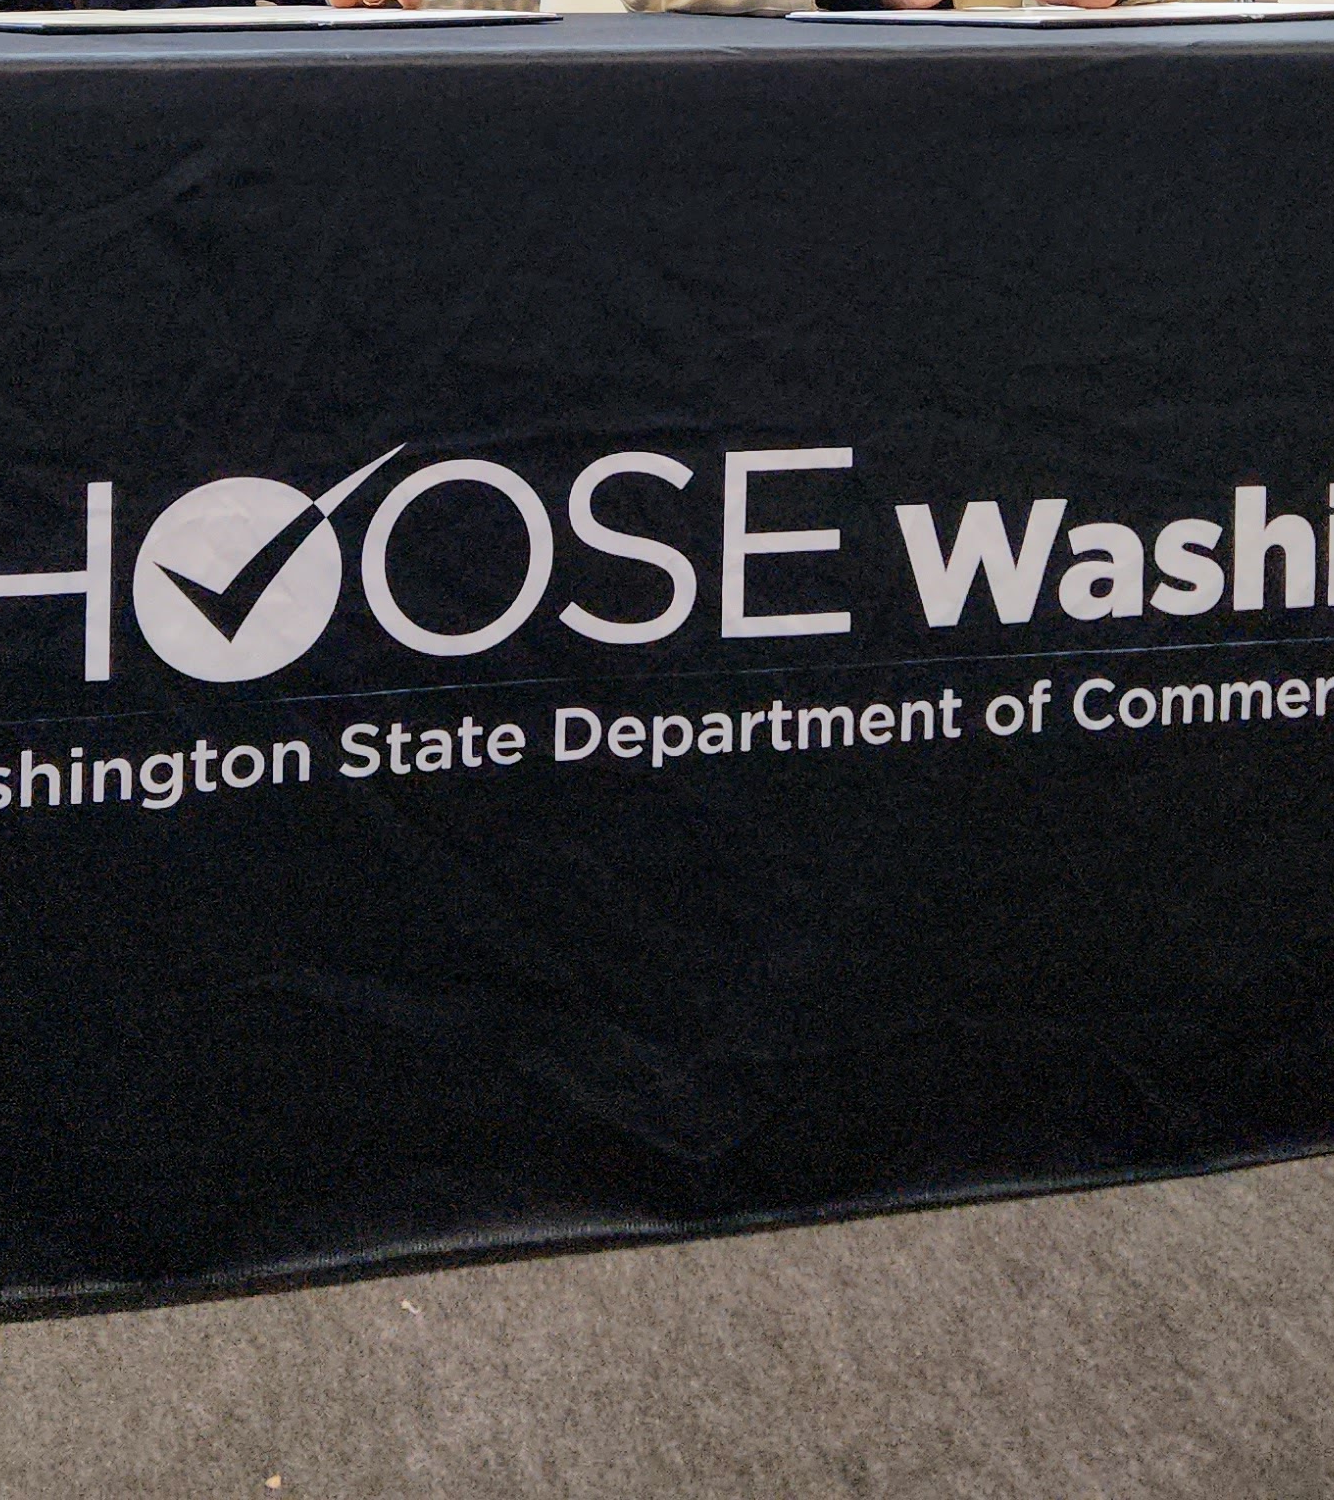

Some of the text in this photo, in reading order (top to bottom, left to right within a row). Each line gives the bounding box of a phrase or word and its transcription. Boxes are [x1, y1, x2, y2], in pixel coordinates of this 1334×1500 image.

[339, 716, 526, 778] State
[554, 688, 963, 762] Department
[986, 678, 1052, 736] of
